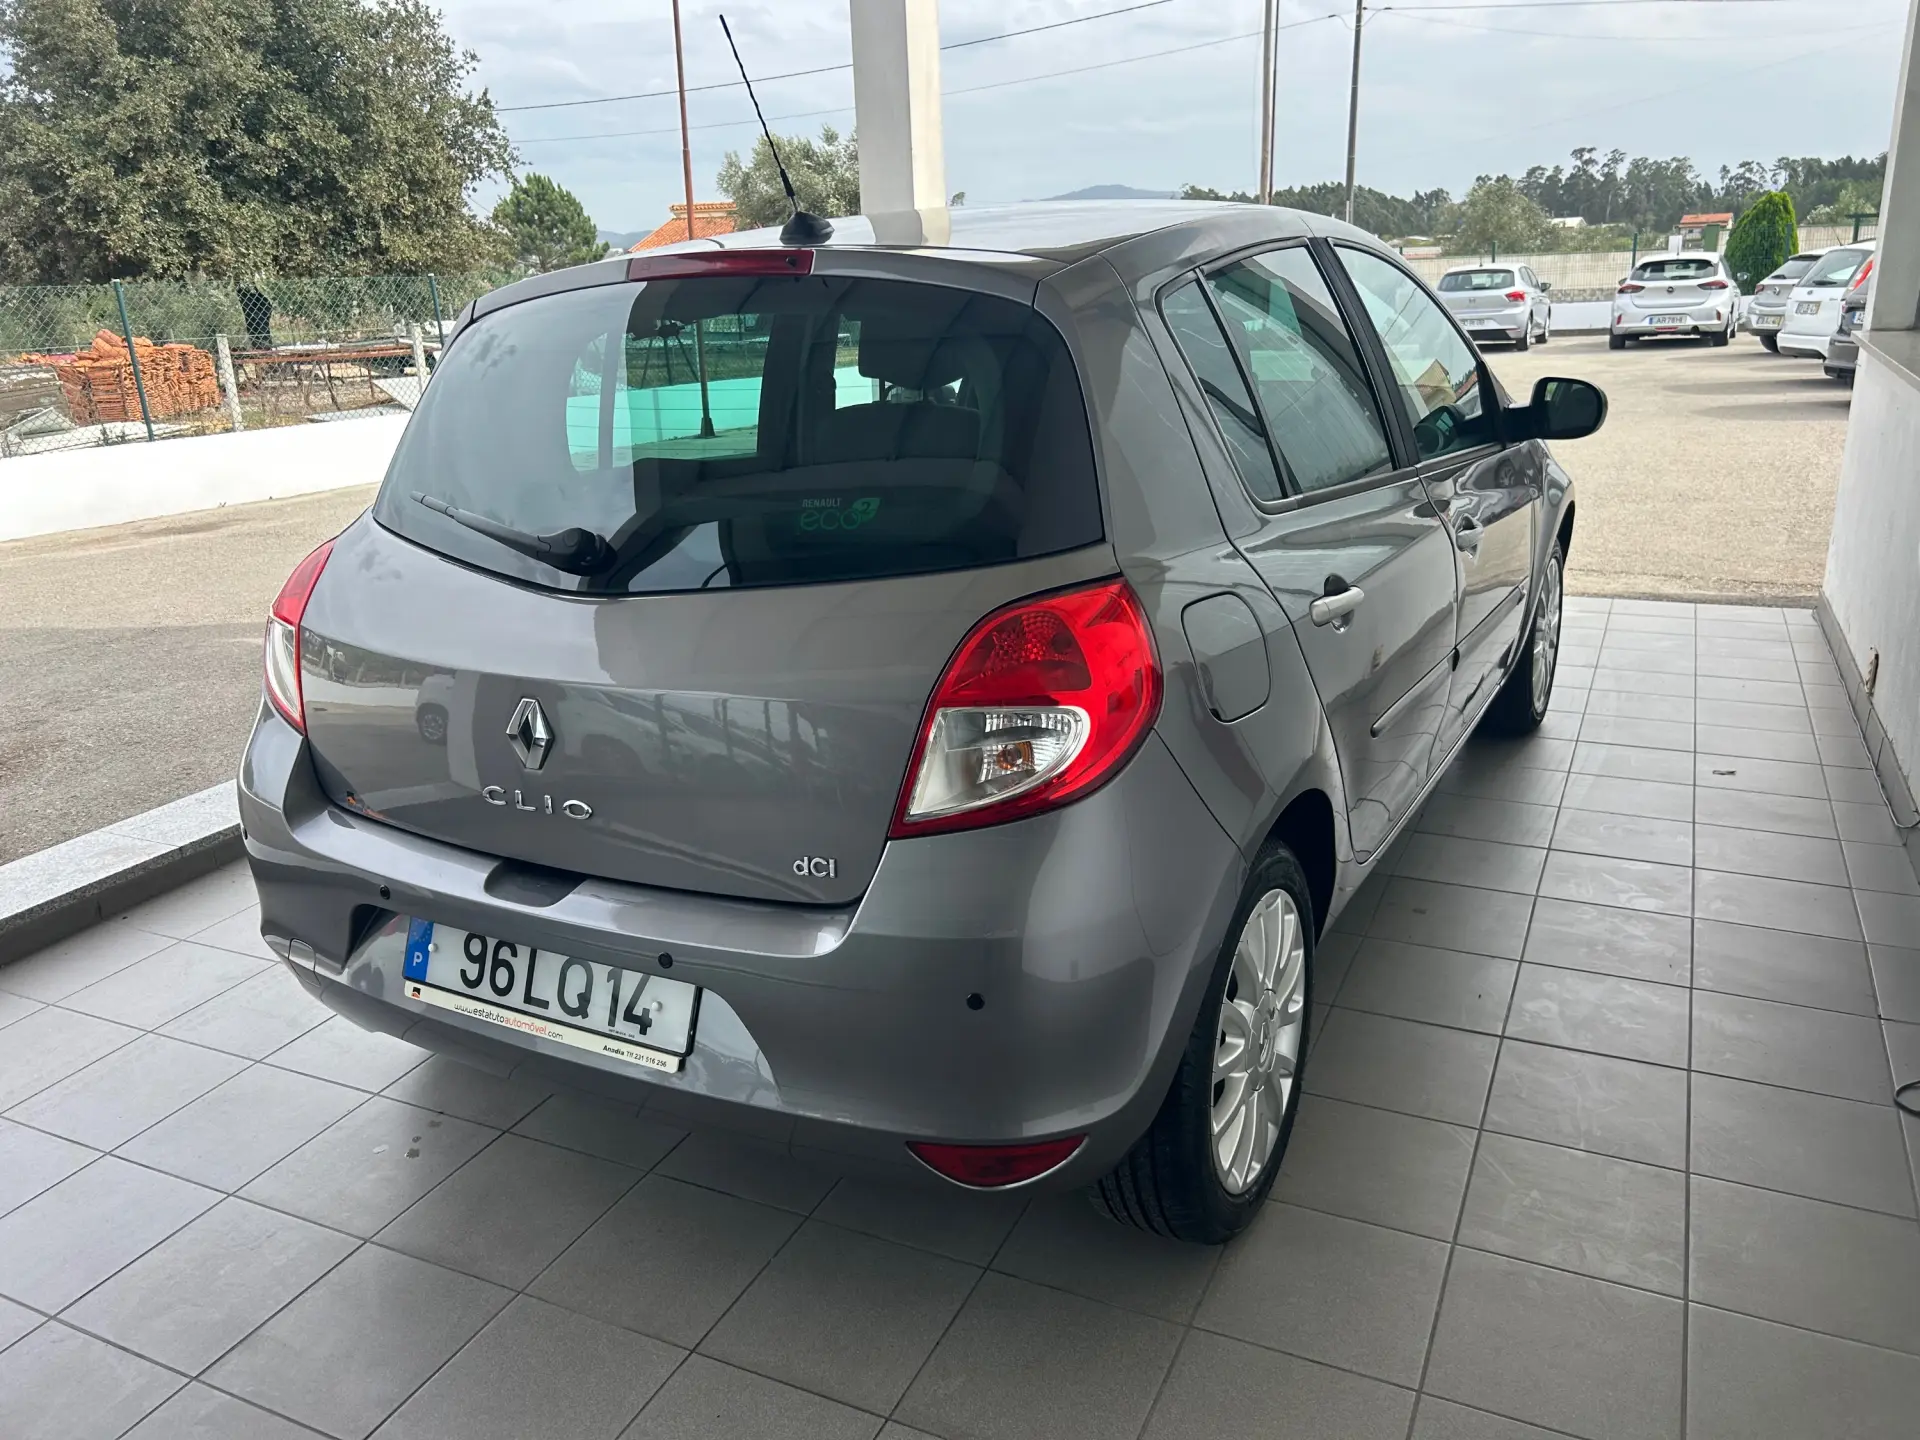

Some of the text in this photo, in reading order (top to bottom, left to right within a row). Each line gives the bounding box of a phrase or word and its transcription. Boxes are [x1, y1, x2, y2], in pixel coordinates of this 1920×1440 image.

[801, 498, 841, 508] RENAULT
[482, 785, 593, 820] CLIO
[413, 951, 423, 967] P
[460, 932, 653, 1036] 96LQ14
[634, 1053, 645, 1062] 231
[645, 1056, 656, 1065] 516
[656, 1059, 668, 1068] 256
